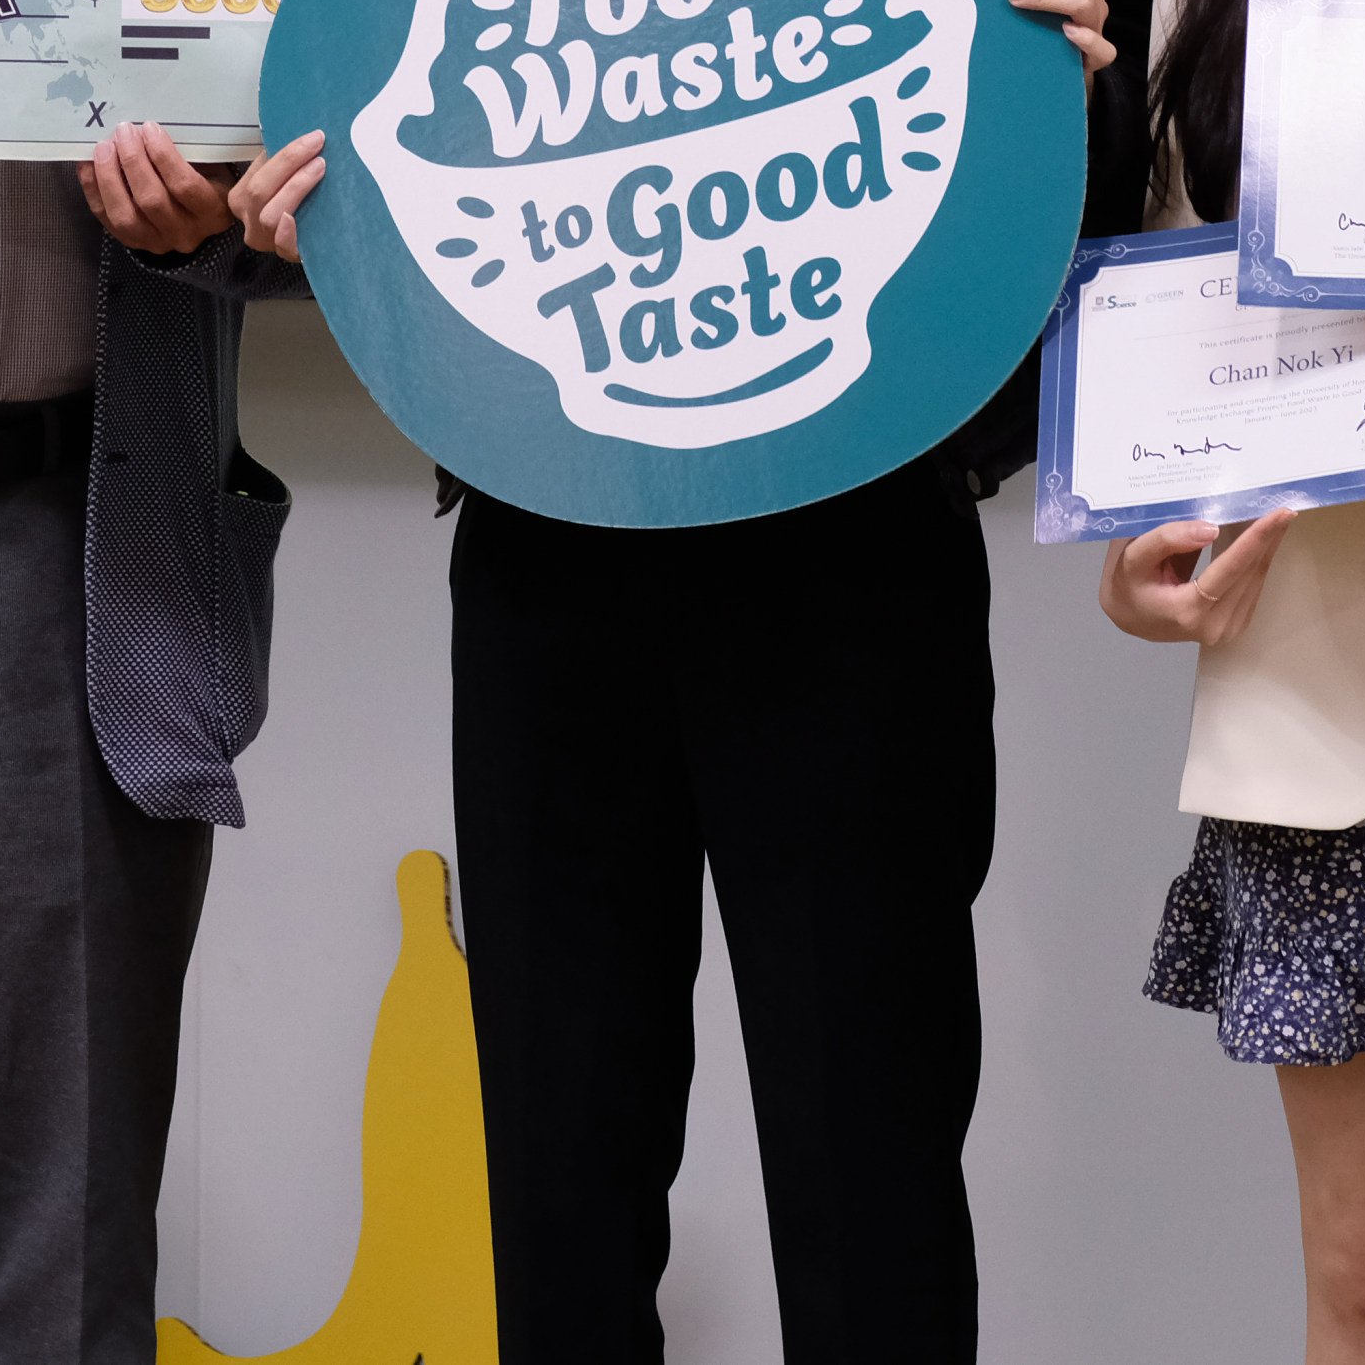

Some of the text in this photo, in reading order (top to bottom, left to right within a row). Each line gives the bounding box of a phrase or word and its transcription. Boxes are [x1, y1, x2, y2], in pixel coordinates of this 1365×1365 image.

[85, 101, 107, 128] X
[463, 8, 828, 159] Waste
[520, 95, 894, 289] to Good
[537, 244, 843, 375] Taste
[1219, 334, 1263, 347] certificate
[1275, 325, 1309, 340] proudly
[1311, 316, 1354, 332] presented
[1209, 344, 1355, 386] Chan Nok Yi
